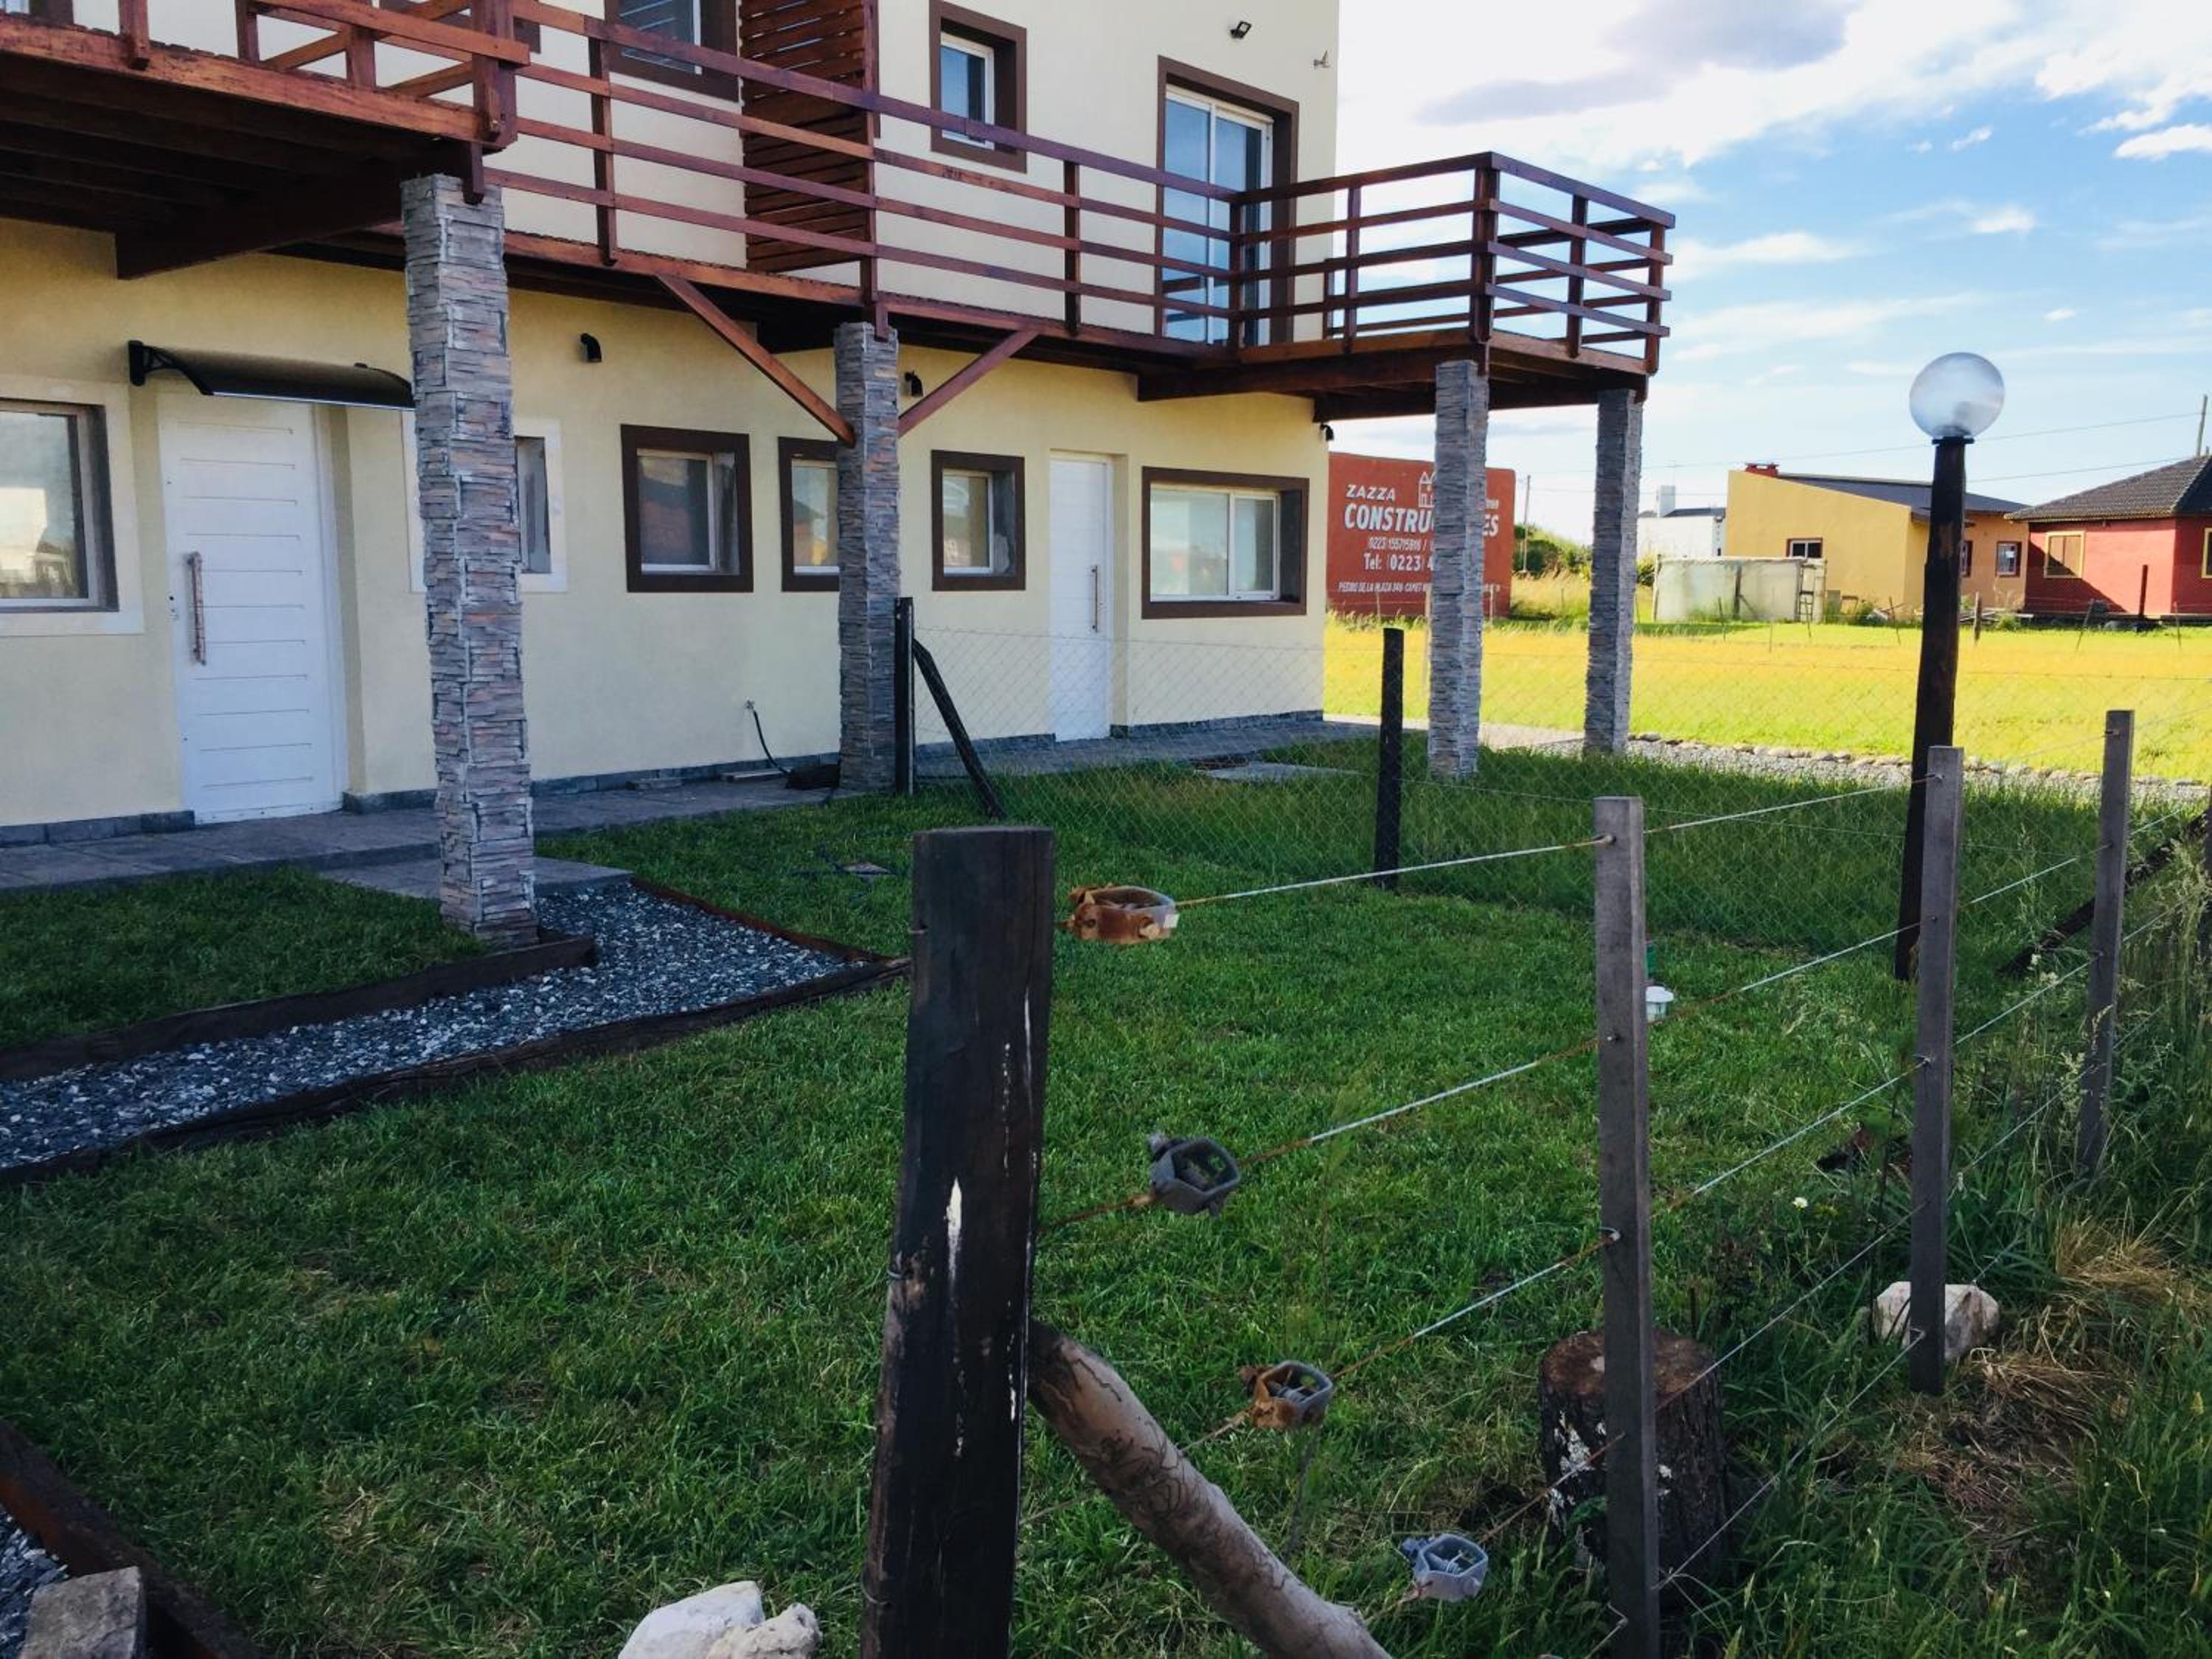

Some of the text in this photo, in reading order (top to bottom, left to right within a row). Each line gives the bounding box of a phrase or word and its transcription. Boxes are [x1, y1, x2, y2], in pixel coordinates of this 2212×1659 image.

[1346, 484, 1396, 501] ZAZZA
[1344, 503, 1499, 538] CONSTRUES
[1363, 552, 1382, 570] Tel:
